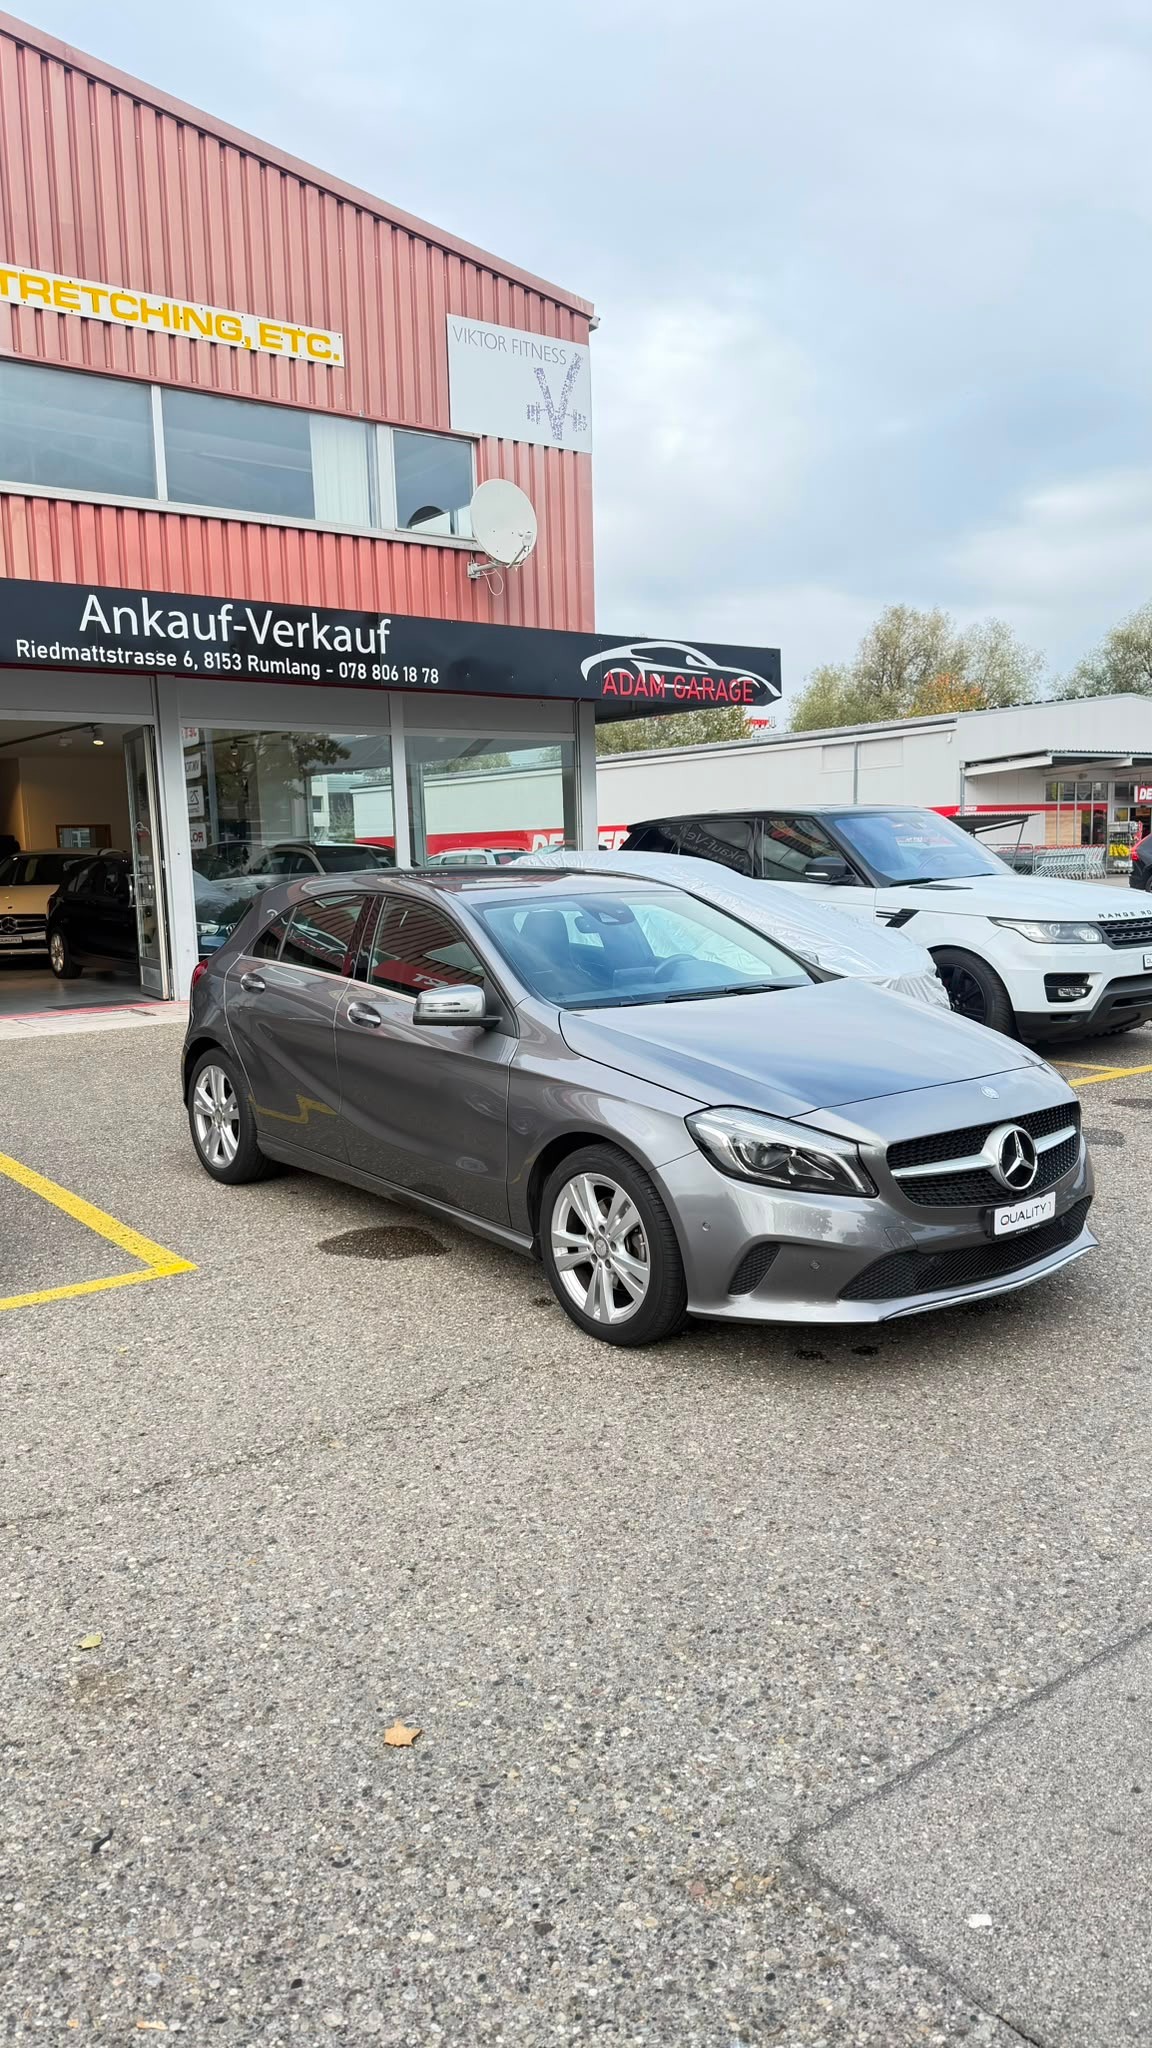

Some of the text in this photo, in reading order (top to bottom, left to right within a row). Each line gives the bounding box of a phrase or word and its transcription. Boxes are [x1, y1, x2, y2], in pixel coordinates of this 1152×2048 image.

[0, 269, 340, 361] TRETCHING, ETC.
[453, 326, 567, 365] VIKTOR FITNESS
[79, 594, 391, 654] Ankauf-Verkauf
[16, 639, 177, 667] Riedmattstrasse
[183, 650, 199, 671] 6,
[204, 651, 242, 671] 8153
[248, 655, 320, 680] Rumlang
[339, 661, 367, 679] 078
[372, 663, 399, 681] 806
[403, 666, 418, 682] 18
[422, 668, 439, 684] 78
[603, 671, 754, 702] ADAM GARAGE
[1000, 1203, 1047, 1226] QUALITY
